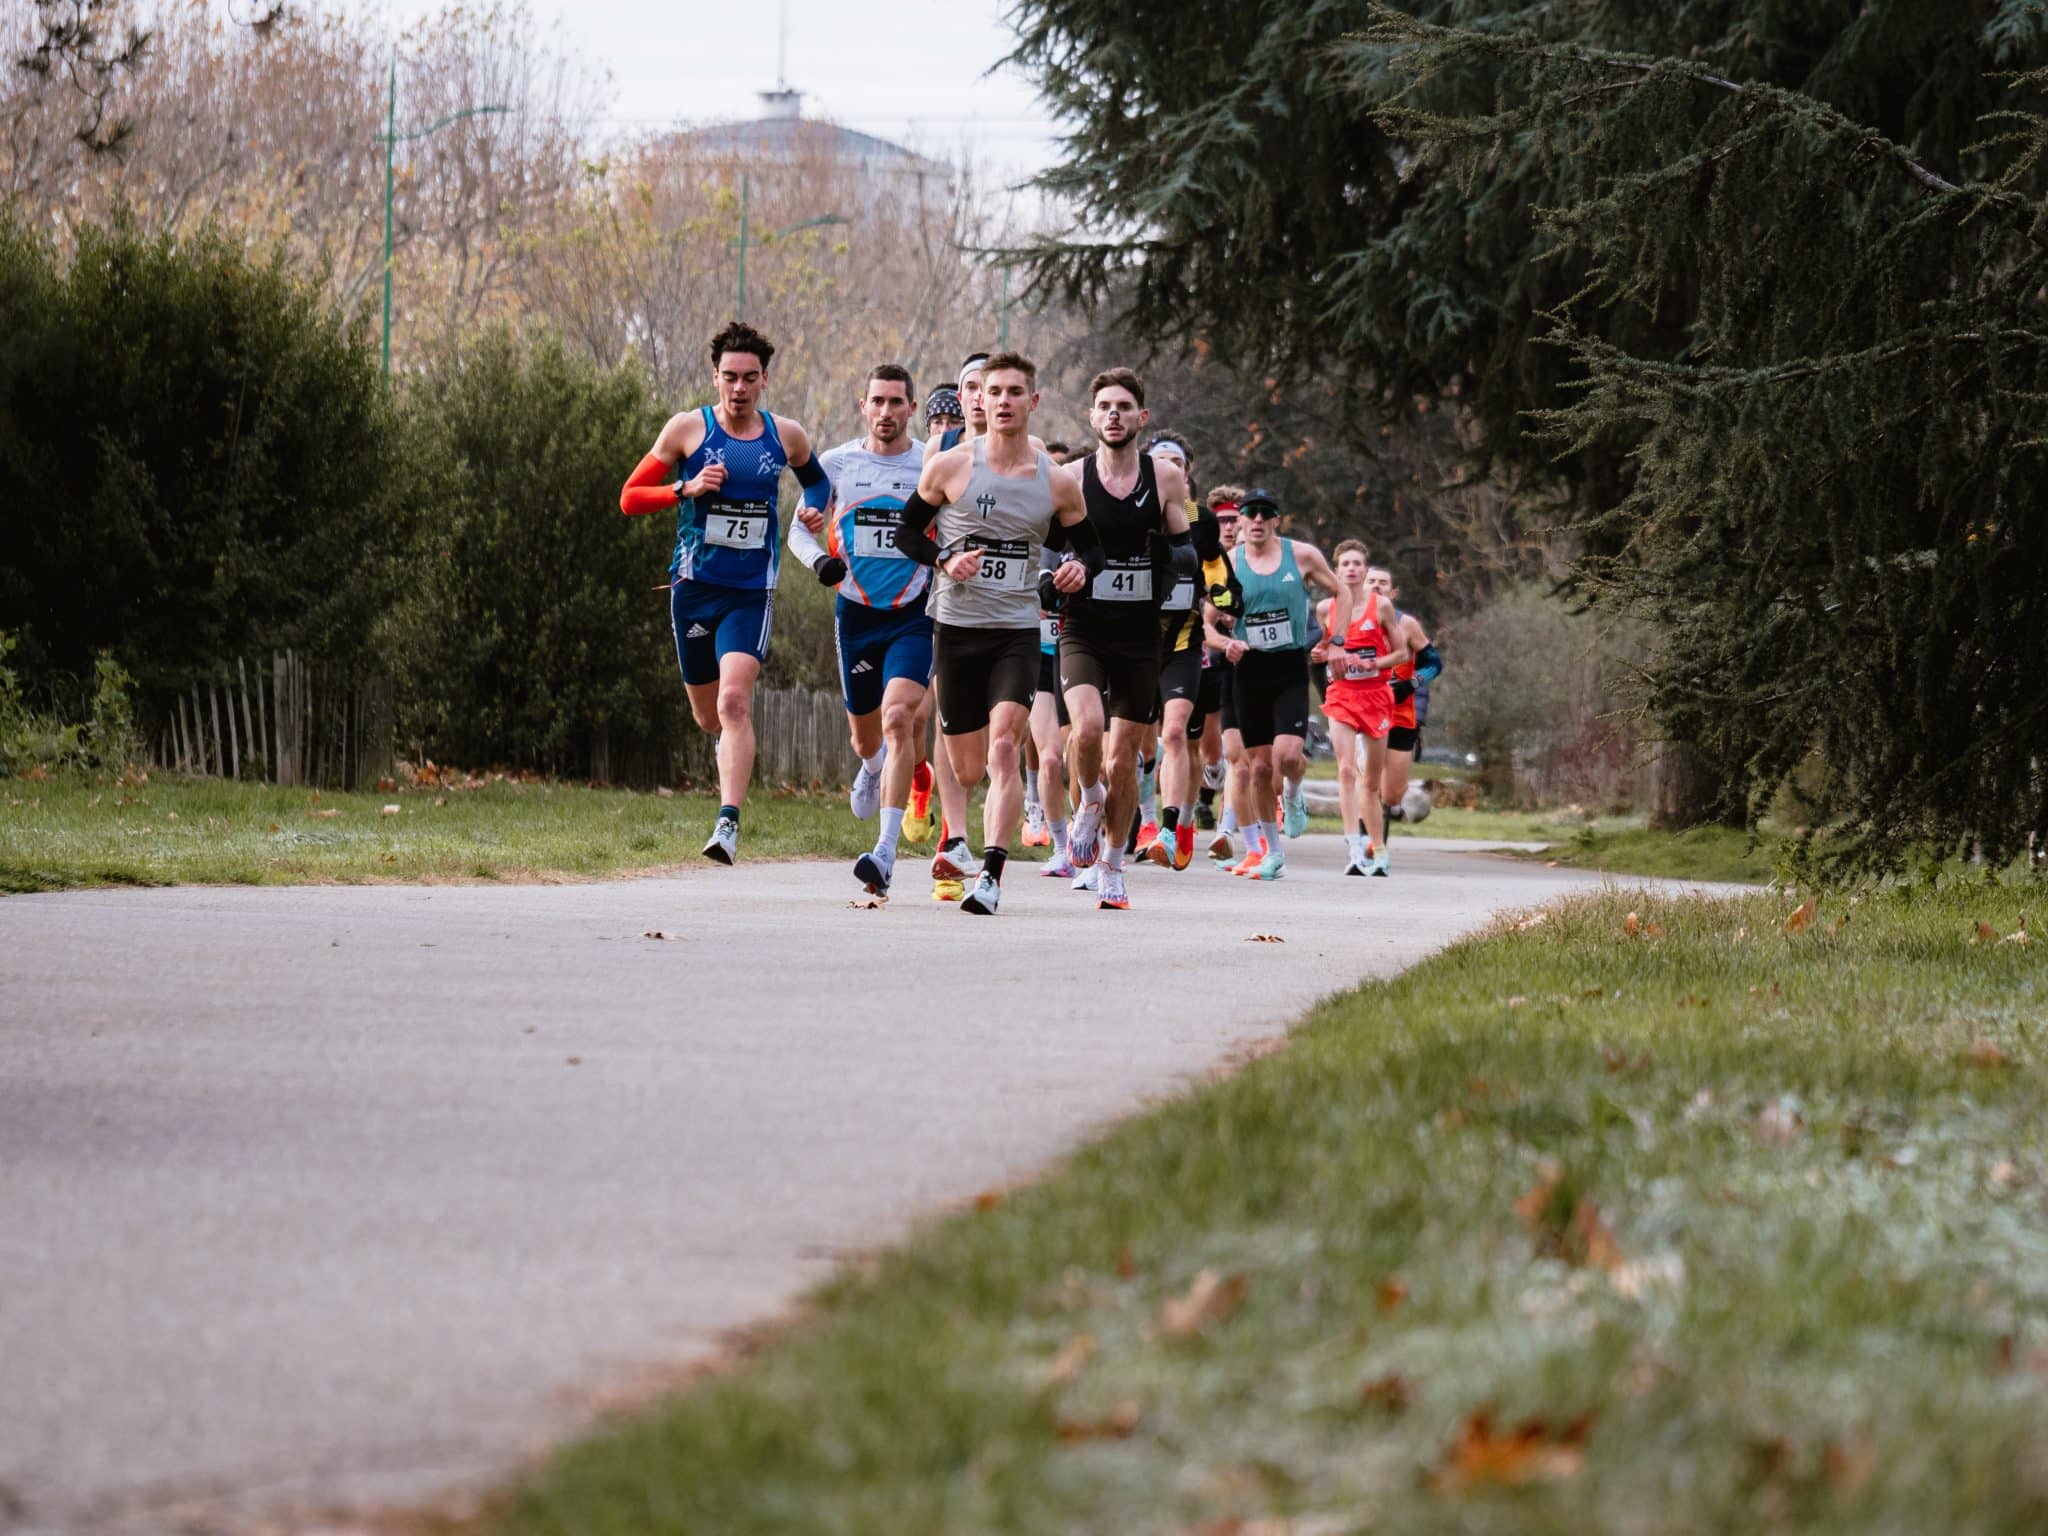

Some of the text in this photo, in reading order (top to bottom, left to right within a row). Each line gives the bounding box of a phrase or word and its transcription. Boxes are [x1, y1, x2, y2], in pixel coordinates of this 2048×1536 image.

[726, 519, 749, 540] 75
[873, 529, 897, 549] 15
[980, 559, 1007, 580] 58
[1112, 572, 1134, 592] 41
[1259, 626, 1277, 642] 18
